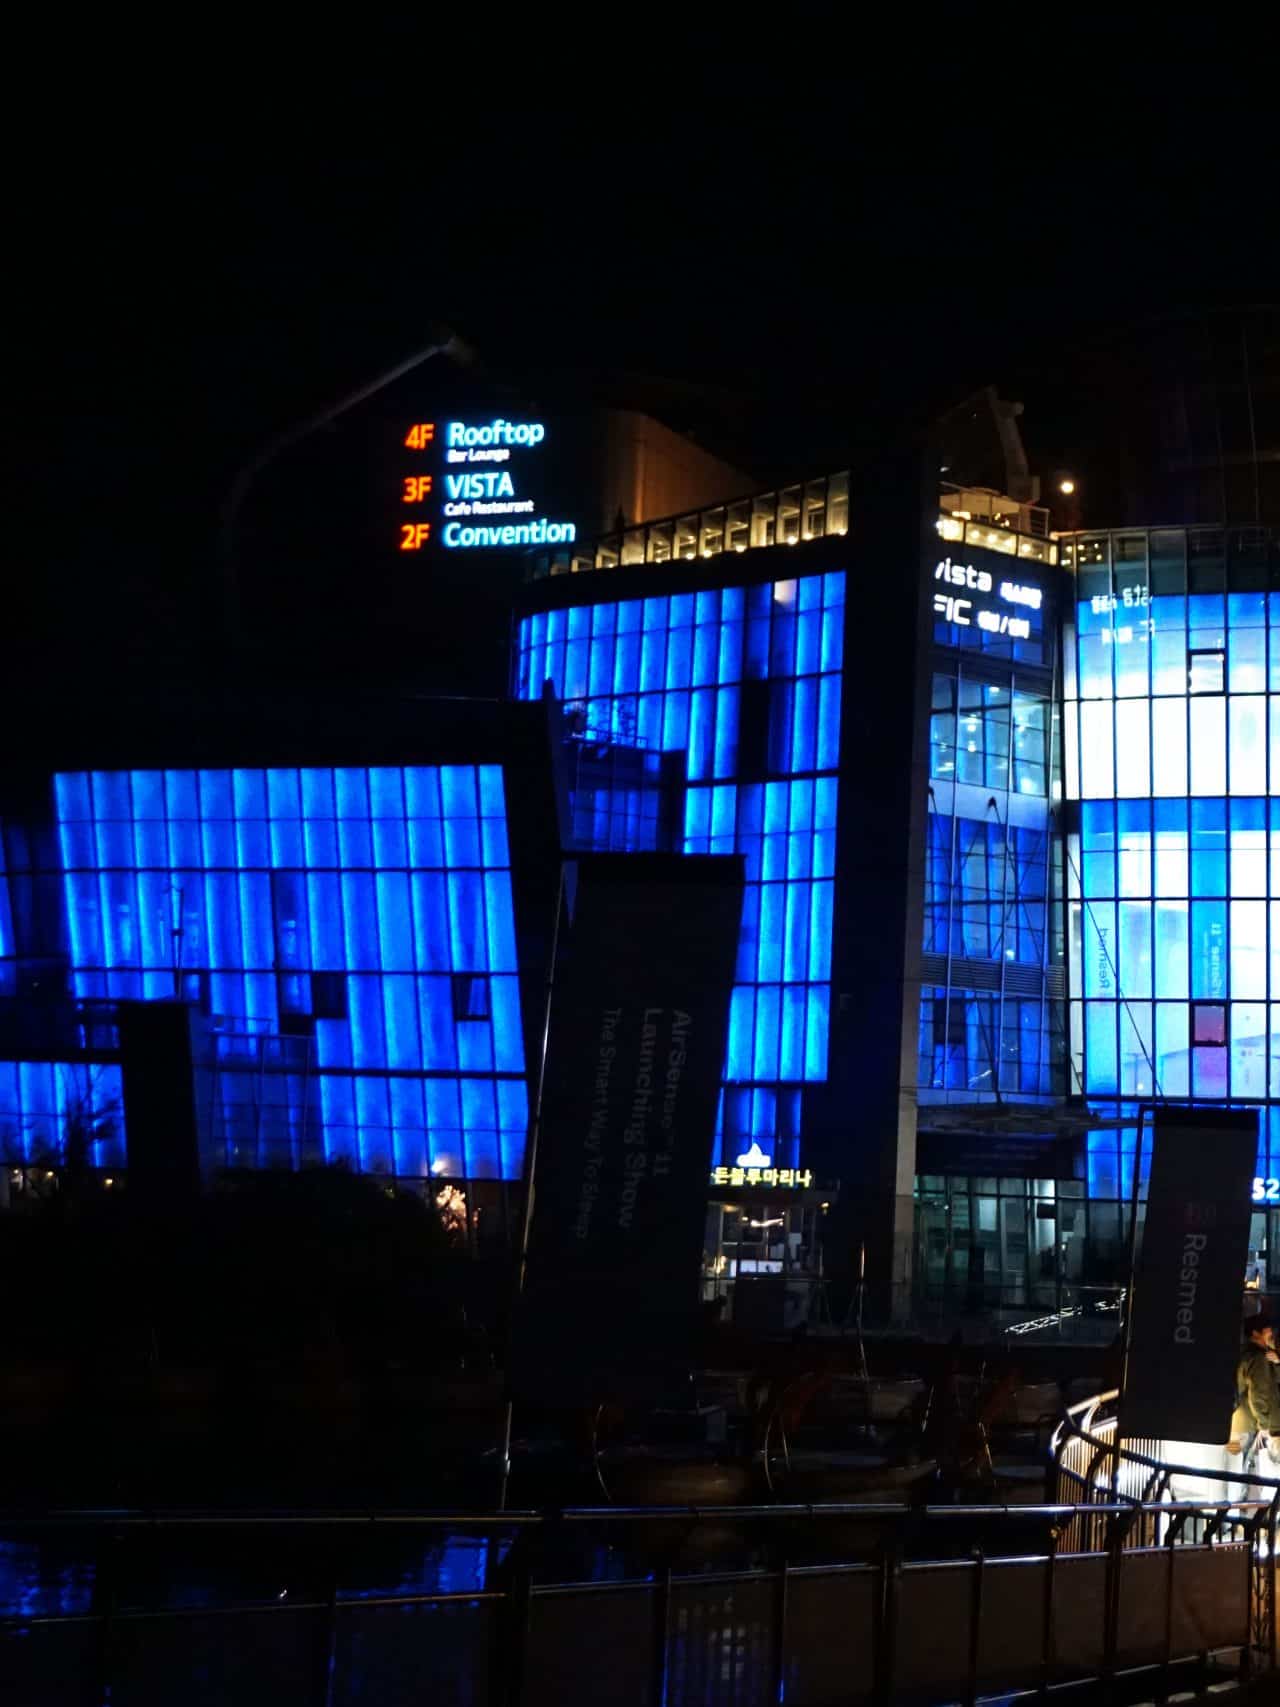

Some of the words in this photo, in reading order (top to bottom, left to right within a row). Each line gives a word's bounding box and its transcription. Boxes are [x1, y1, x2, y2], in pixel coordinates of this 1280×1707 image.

[404, 424, 434, 449] 4F
[448, 419, 545, 447] Rooftop
[403, 476, 432, 502] 3F
[447, 472, 514, 499] VISTA
[473, 500, 534, 515] Restaurant
[400, 523, 430, 549] 2F
[445, 518, 576, 547] Convention
[624, 1008, 664, 1145] Launching
[711, 1167, 812, 1187] 든블루마리나
[1173, 1232, 1208, 1344] Resmed
